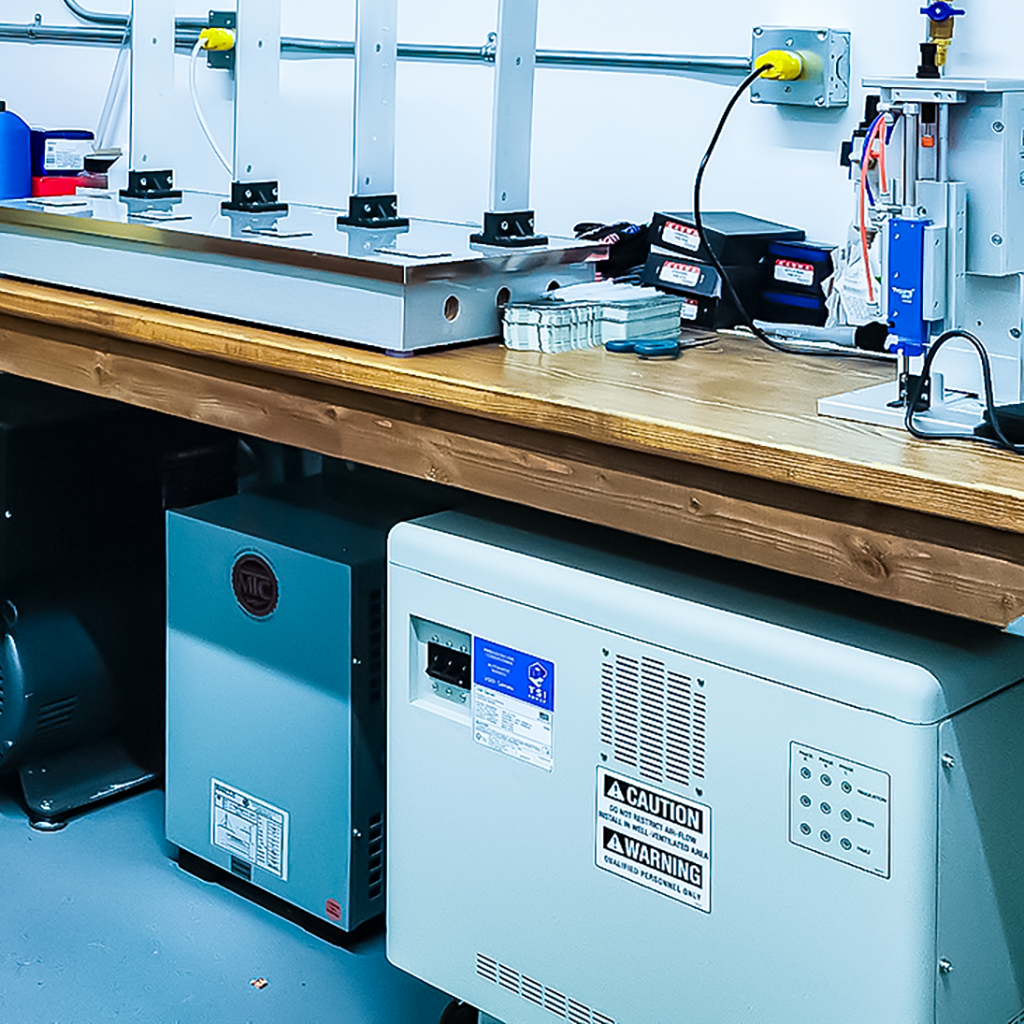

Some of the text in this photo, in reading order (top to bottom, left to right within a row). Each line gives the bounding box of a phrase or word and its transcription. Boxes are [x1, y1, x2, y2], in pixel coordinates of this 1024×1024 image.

[528, 684, 547, 699] TSI
[609, 804, 697, 844] DO NOT RESTRICT AIR-FLOW
[626, 785, 700, 831] CAUTION
[598, 810, 709, 860] INSTALL IN WELL-VENTILATED AREA
[603, 854, 701, 901] QUALIFIED PERSONNEL ONLY
[623, 835, 702, 887] WARNING
